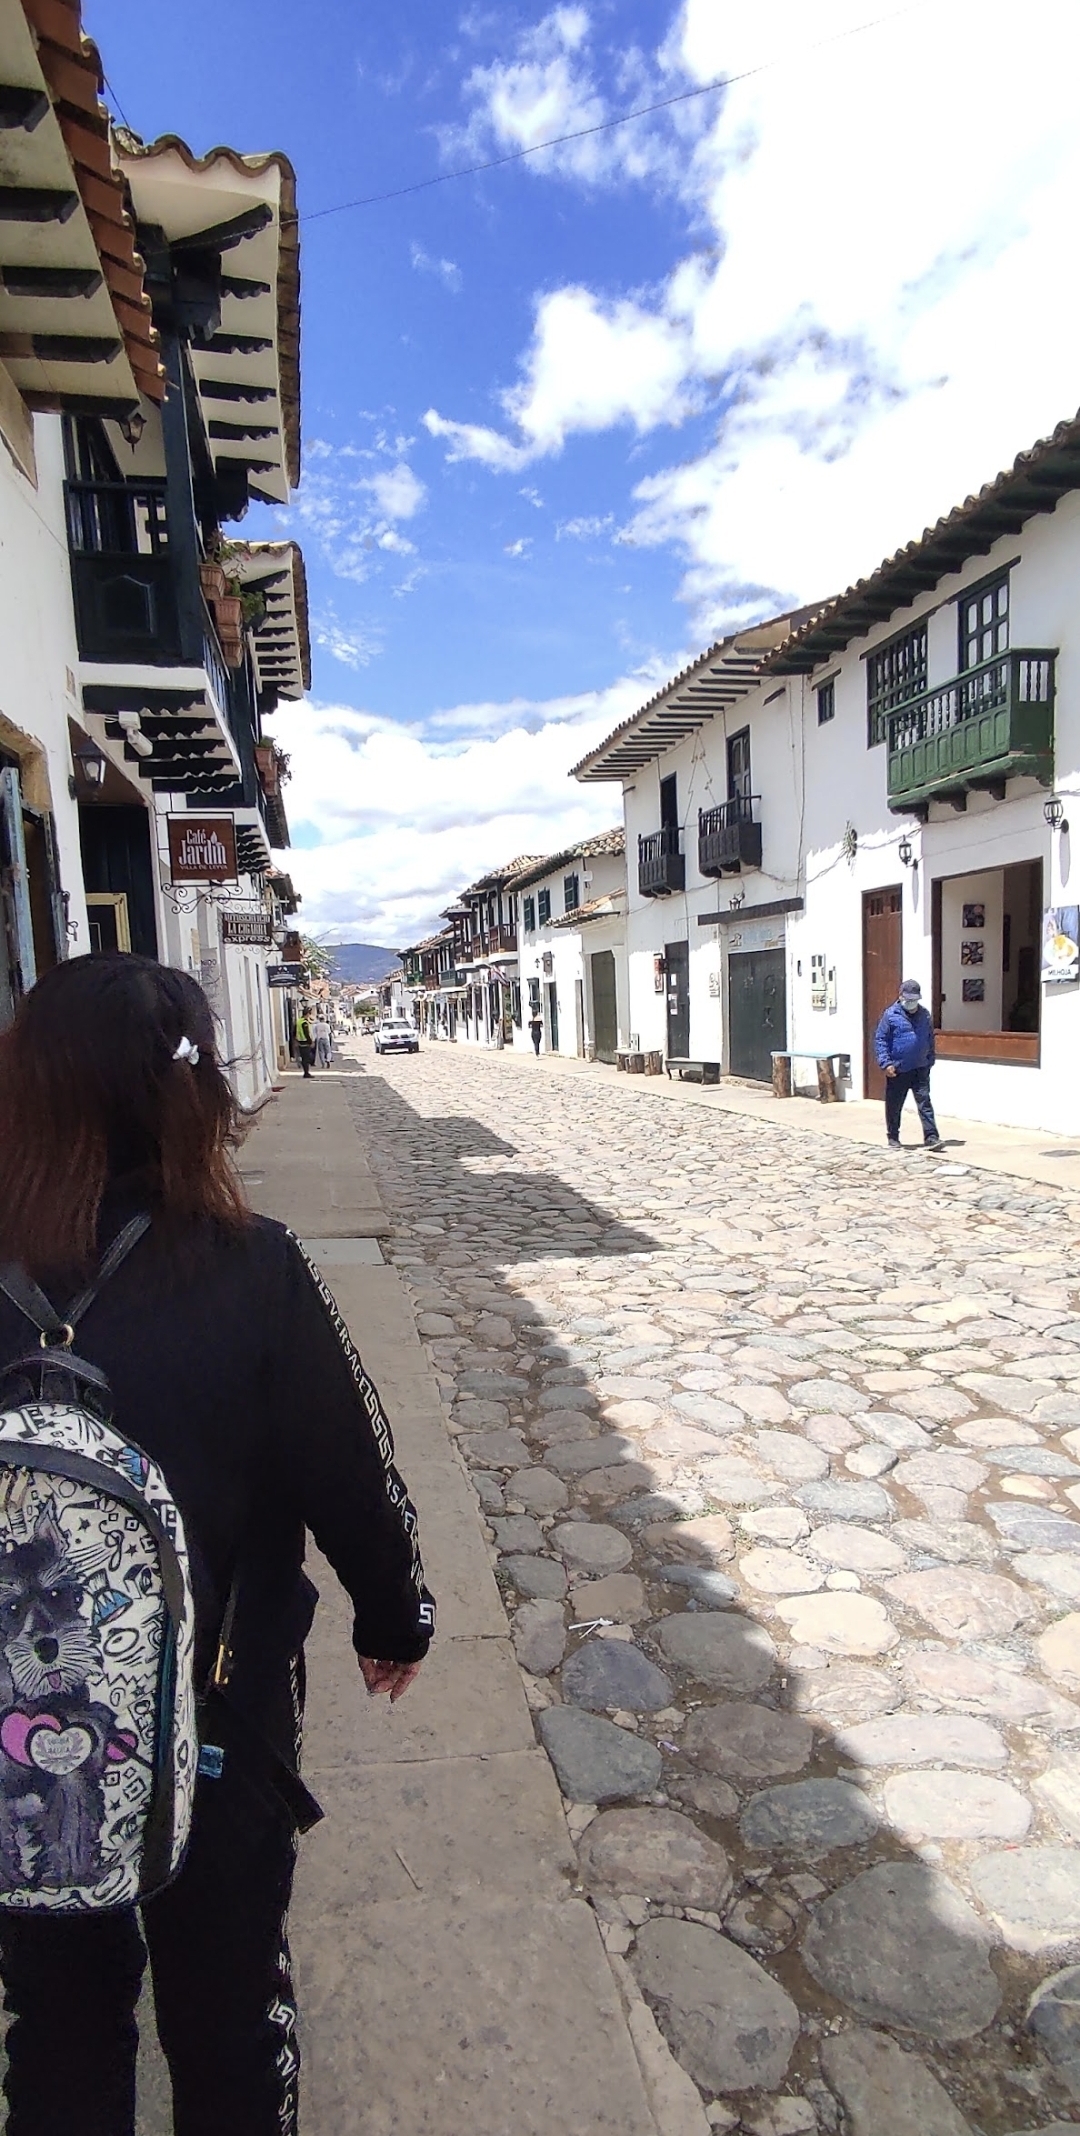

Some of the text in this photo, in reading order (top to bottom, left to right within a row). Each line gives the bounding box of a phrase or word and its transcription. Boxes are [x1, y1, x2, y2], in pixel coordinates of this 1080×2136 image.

[186, 828, 207, 845] Café
[178, 839, 227, 865] Jardín
[228, 922, 237, 934] LA
[223, 935, 271, 943] express
[330, 1301, 368, 1393] VERSACE
